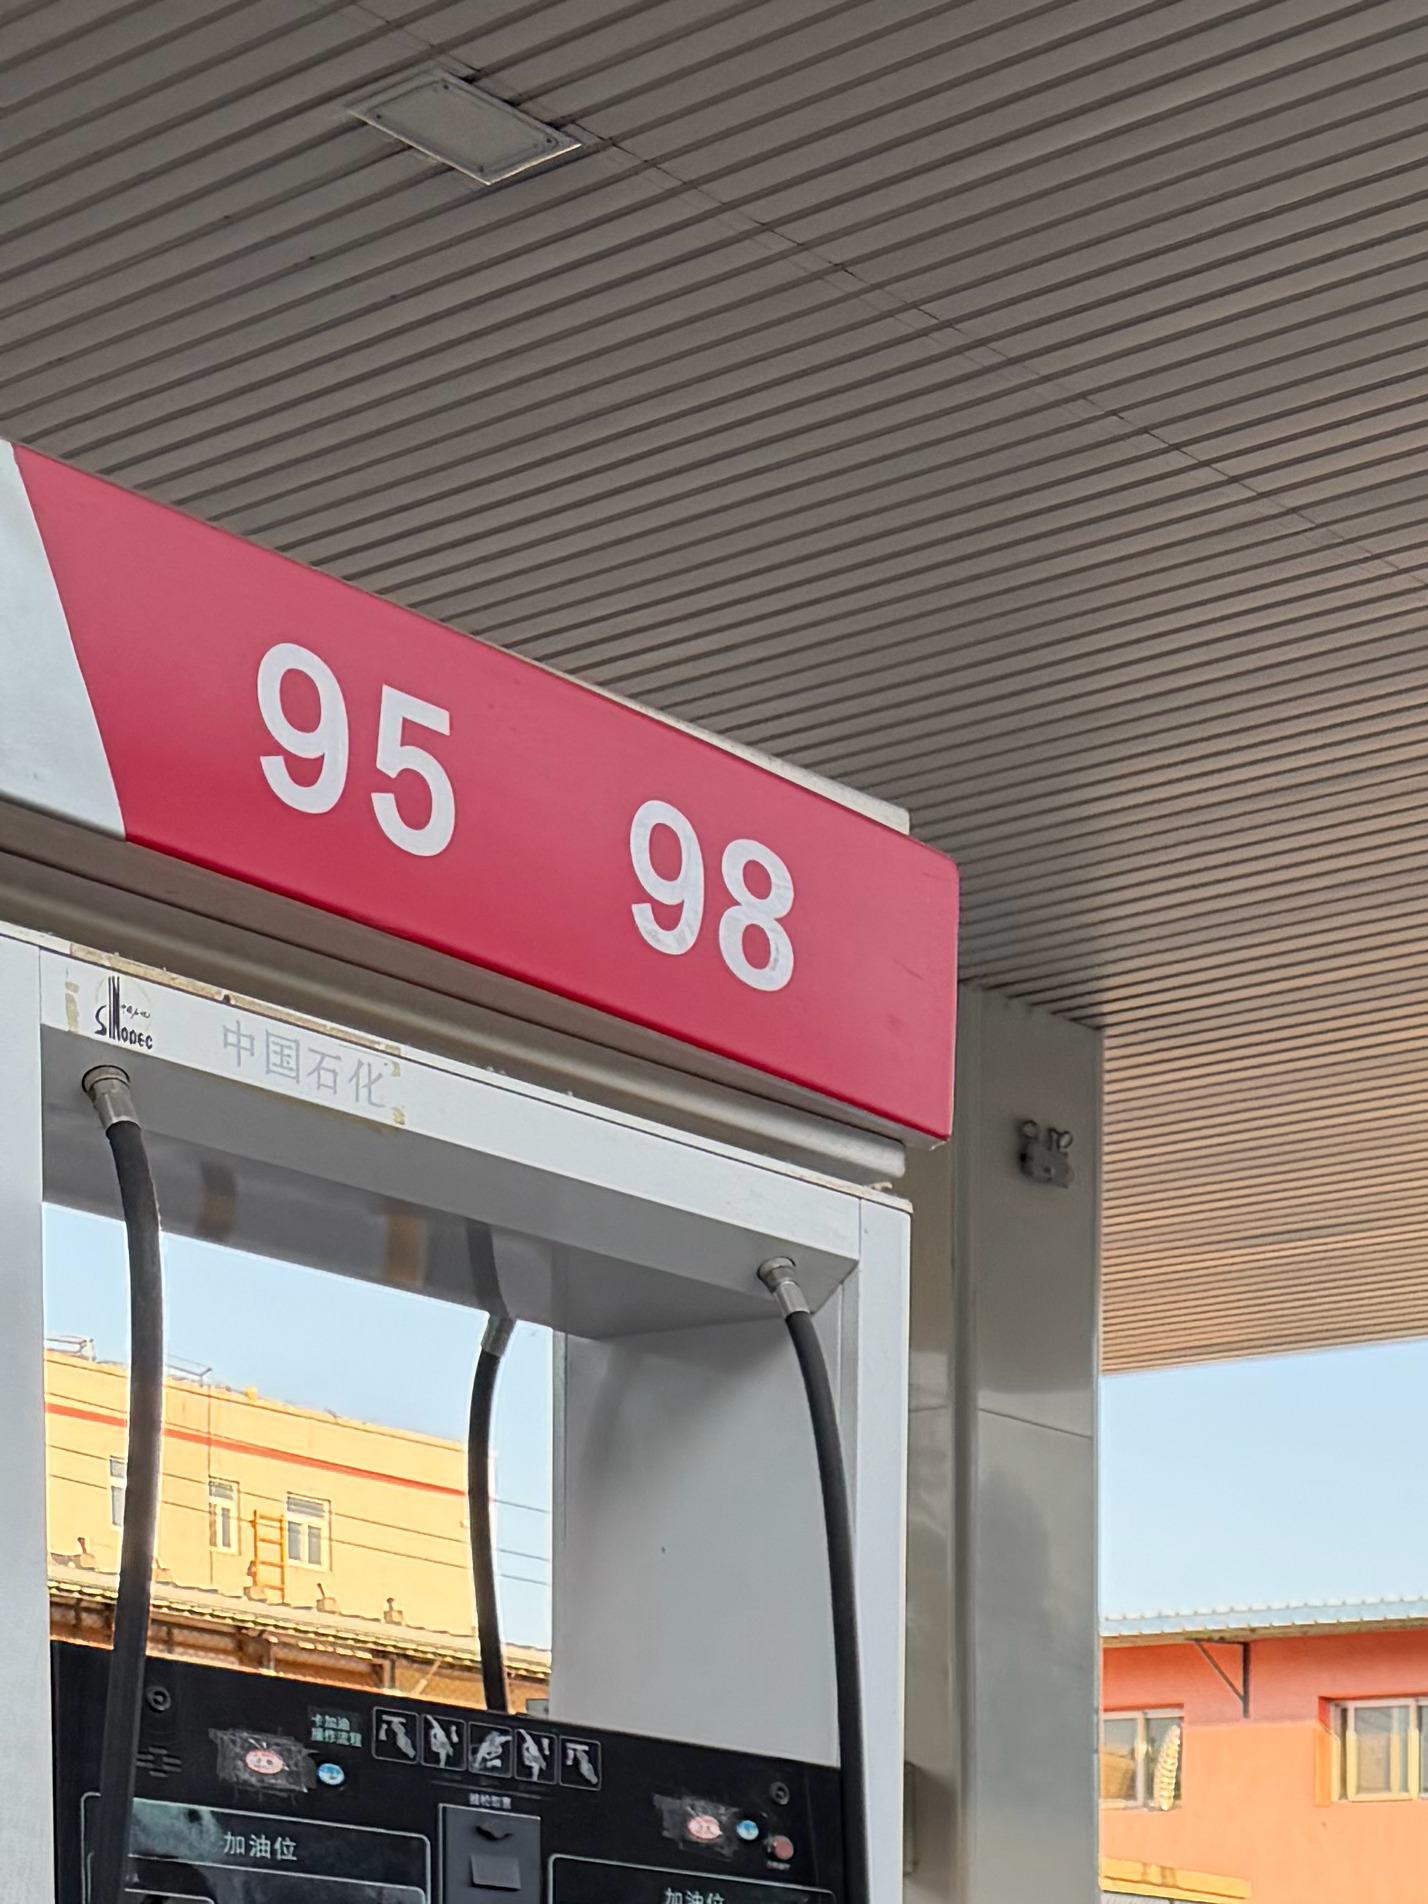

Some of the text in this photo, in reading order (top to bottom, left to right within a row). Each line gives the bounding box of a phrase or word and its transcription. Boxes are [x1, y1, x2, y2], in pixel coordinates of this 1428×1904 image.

[257, 642, 796, 992] 95 98
[222, 1019, 388, 1108] 中国石化
[223, 1831, 298, 1862] 加油位
